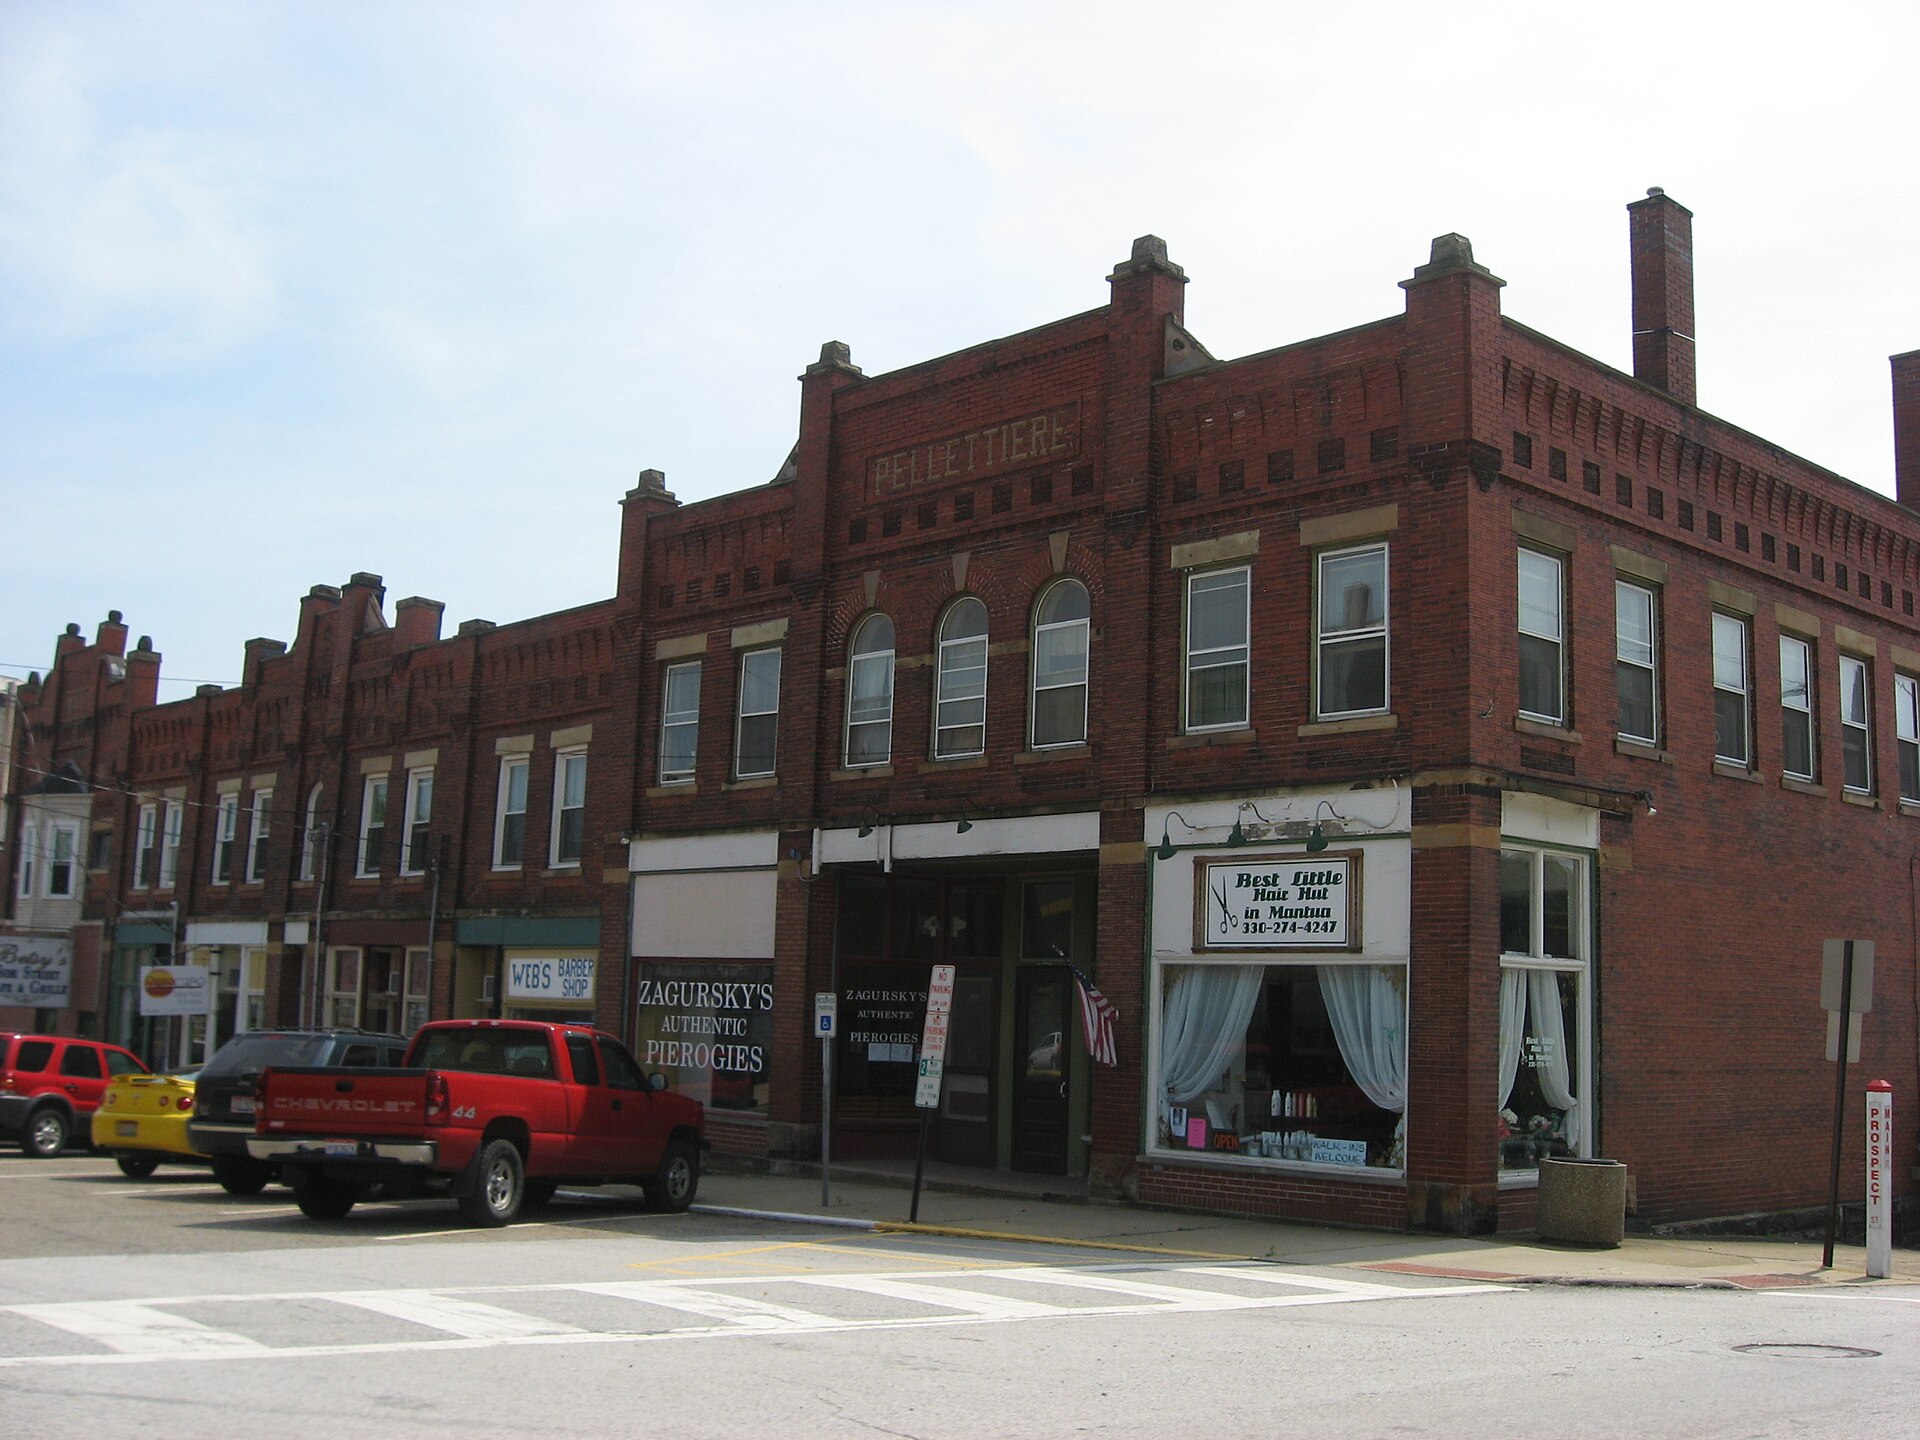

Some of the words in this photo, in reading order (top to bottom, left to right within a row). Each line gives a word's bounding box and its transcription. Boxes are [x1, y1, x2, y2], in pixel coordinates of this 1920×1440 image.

[874, 410, 1068, 496] PELLETTIERE
[1235, 872, 1280, 888] Best
[1291, 870, 1343, 886] Little
[1252, 887, 1289, 902] Hair
[1297, 886, 1329, 901] Hut
[1244, 906, 1260, 920] in
[1268, 905, 1332, 920] Mantua
[1242, 920, 1338, 934] 330-274-4247
[512, 961, 551, 989] WEB'S
[558, 958, 595, 977] BARBER
[562, 978, 588, 997] SHOP
[639, 980, 773, 1010] ZAGURSKY'S
[846, 990, 927, 1001] ZAGURSKY'S
[857, 1010, 914, 1019] AUTHENTIC
[661, 1015, 747, 1036] AUTHENTIC
[850, 1032, 919, 1043] PIEROGIES
[645, 1040, 763, 1073] PIEROGIES
[273, 1097, 416, 1113] CHEVROLET
[1214, 1133, 1240, 1150] OPEN
[1314, 1151, 1362, 1164] WELCOME
[1870, 1108, 1880, 1205] PROSPECT
